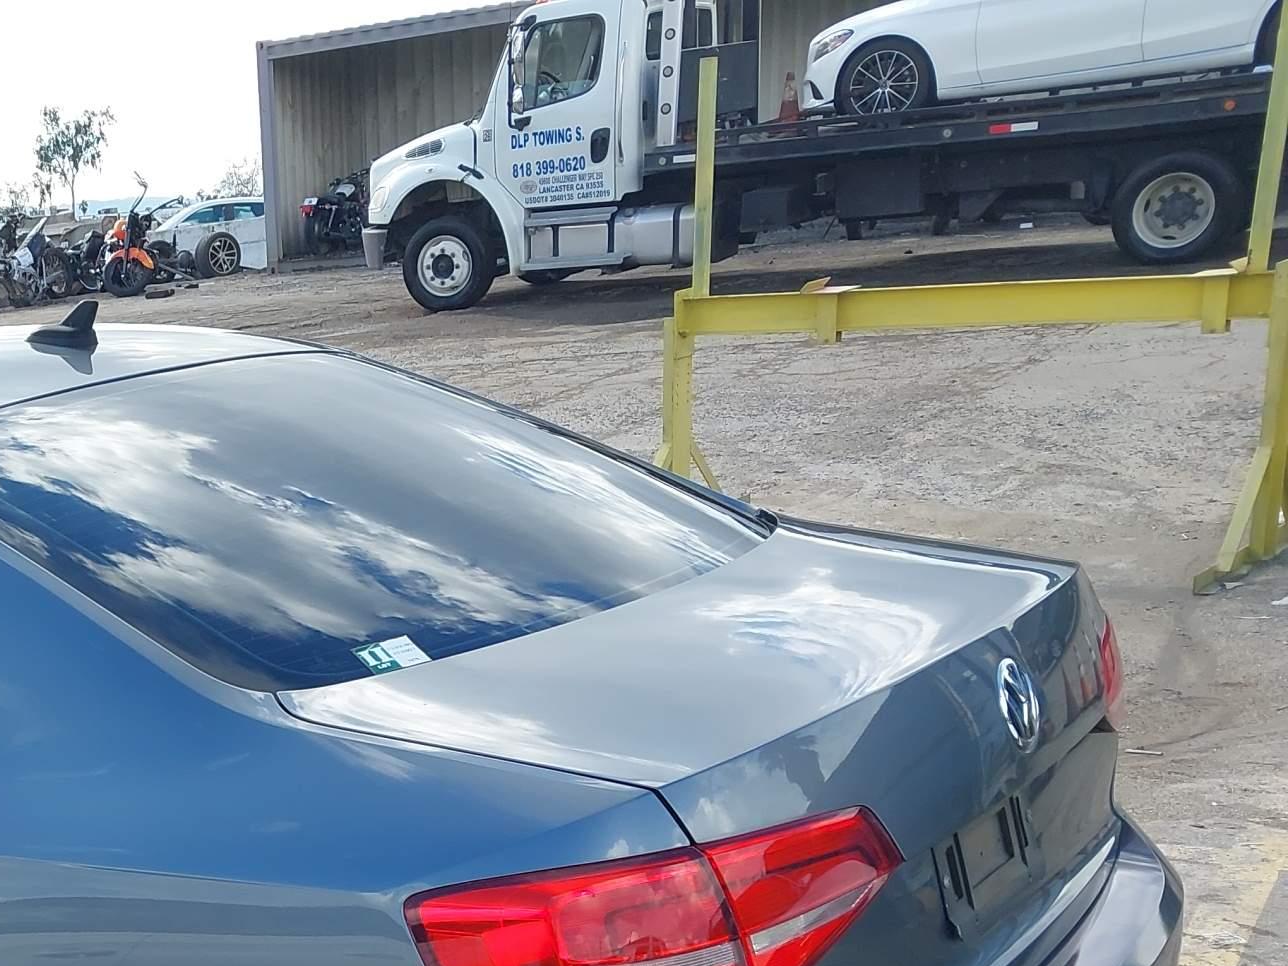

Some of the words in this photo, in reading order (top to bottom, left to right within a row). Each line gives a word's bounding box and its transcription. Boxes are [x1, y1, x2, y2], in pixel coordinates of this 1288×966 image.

[511, 132, 529, 149] DLP
[532, 129, 572, 147] TOWING
[575, 126, 585, 142] S.
[512, 161, 532, 178] 818
[536, 156, 586, 175] 399-0620
[539, 184, 575, 194] LANCASTER
[576, 182, 585, 191] CA
